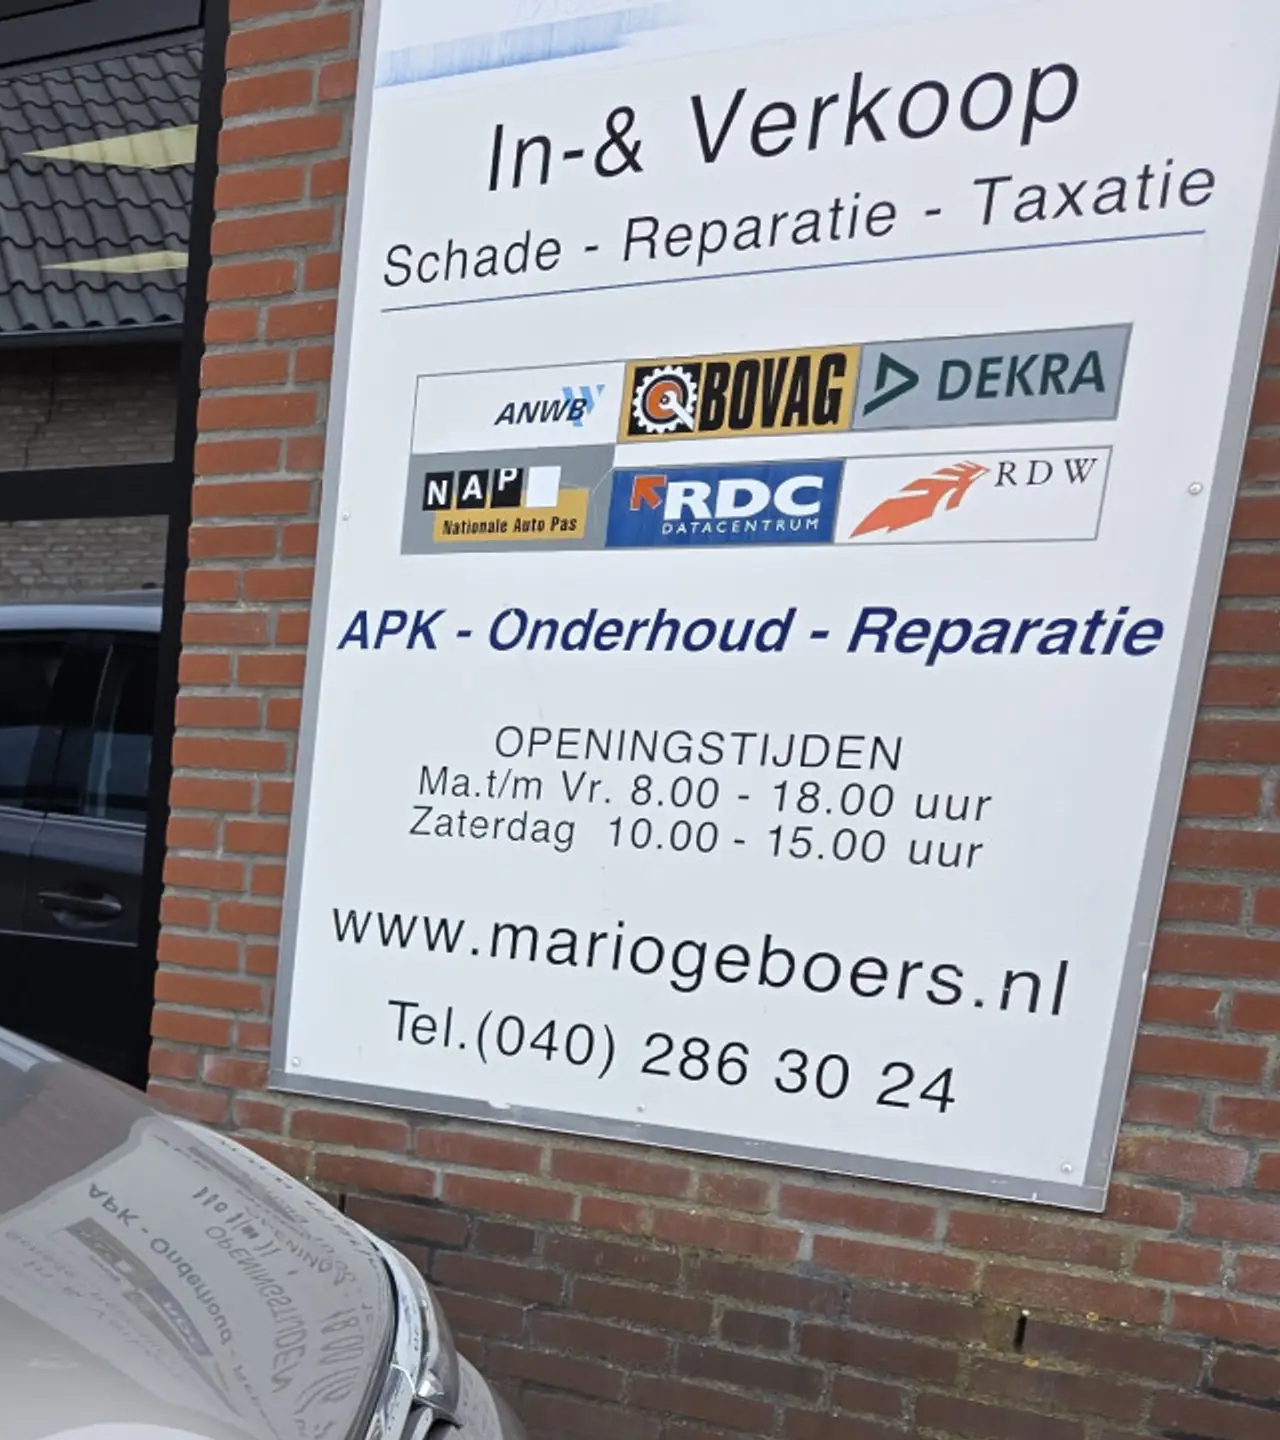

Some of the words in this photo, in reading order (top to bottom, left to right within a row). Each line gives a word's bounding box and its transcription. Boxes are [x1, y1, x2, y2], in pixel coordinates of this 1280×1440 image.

[487, 104, 645, 193] In-&
[690, 63, 1080, 164] Verkoop
[382, 229, 562, 287] Schade
[623, 191, 898, 267] Reparatie
[925, 207, 942, 216] -
[973, 158, 1216, 227] Taxatie
[697, 351, 848, 433] BOVAG
[937, 350, 1107, 402] DEKRA
[494, 398, 589, 425] ANWB
[426, 468, 518, 507] NAP
[663, 475, 824, 520] RDC
[994, 457, 1098, 487] RDW
[442, 516, 508, 536] Nationale
[513, 514, 546, 533] Auto
[550, 515, 578, 532] Pas
[661, 517, 820, 536] DATACENTRUM
[337, 609, 447, 651] APK
[456, 630, 472, 638] -
[488, 607, 798, 656] Onderhoud
[810, 630, 830, 639] -
[846, 605, 1166, 667] Reparatie
[495, 725, 903, 771] OPENINGSTIJDEN
[419, 765, 543, 802] Ma.t/m
[561, 770, 611, 804] Vr.
[631, 774, 720, 810] 8.00
[774, 780, 894, 818] 18.00
[915, 793, 993, 822] uur
[409, 805, 576, 853] Zaterdag
[608, 816, 719, 853] 10.00
[768, 824, 886, 863] 15.00
[908, 838, 984, 869] uur
[332, 906, 1070, 1016] www.mariogeboers.nl
[641, 1032, 750, 1087] 286
[774, 1048, 850, 1100] 30
[876, 1061, 956, 1114] 24
